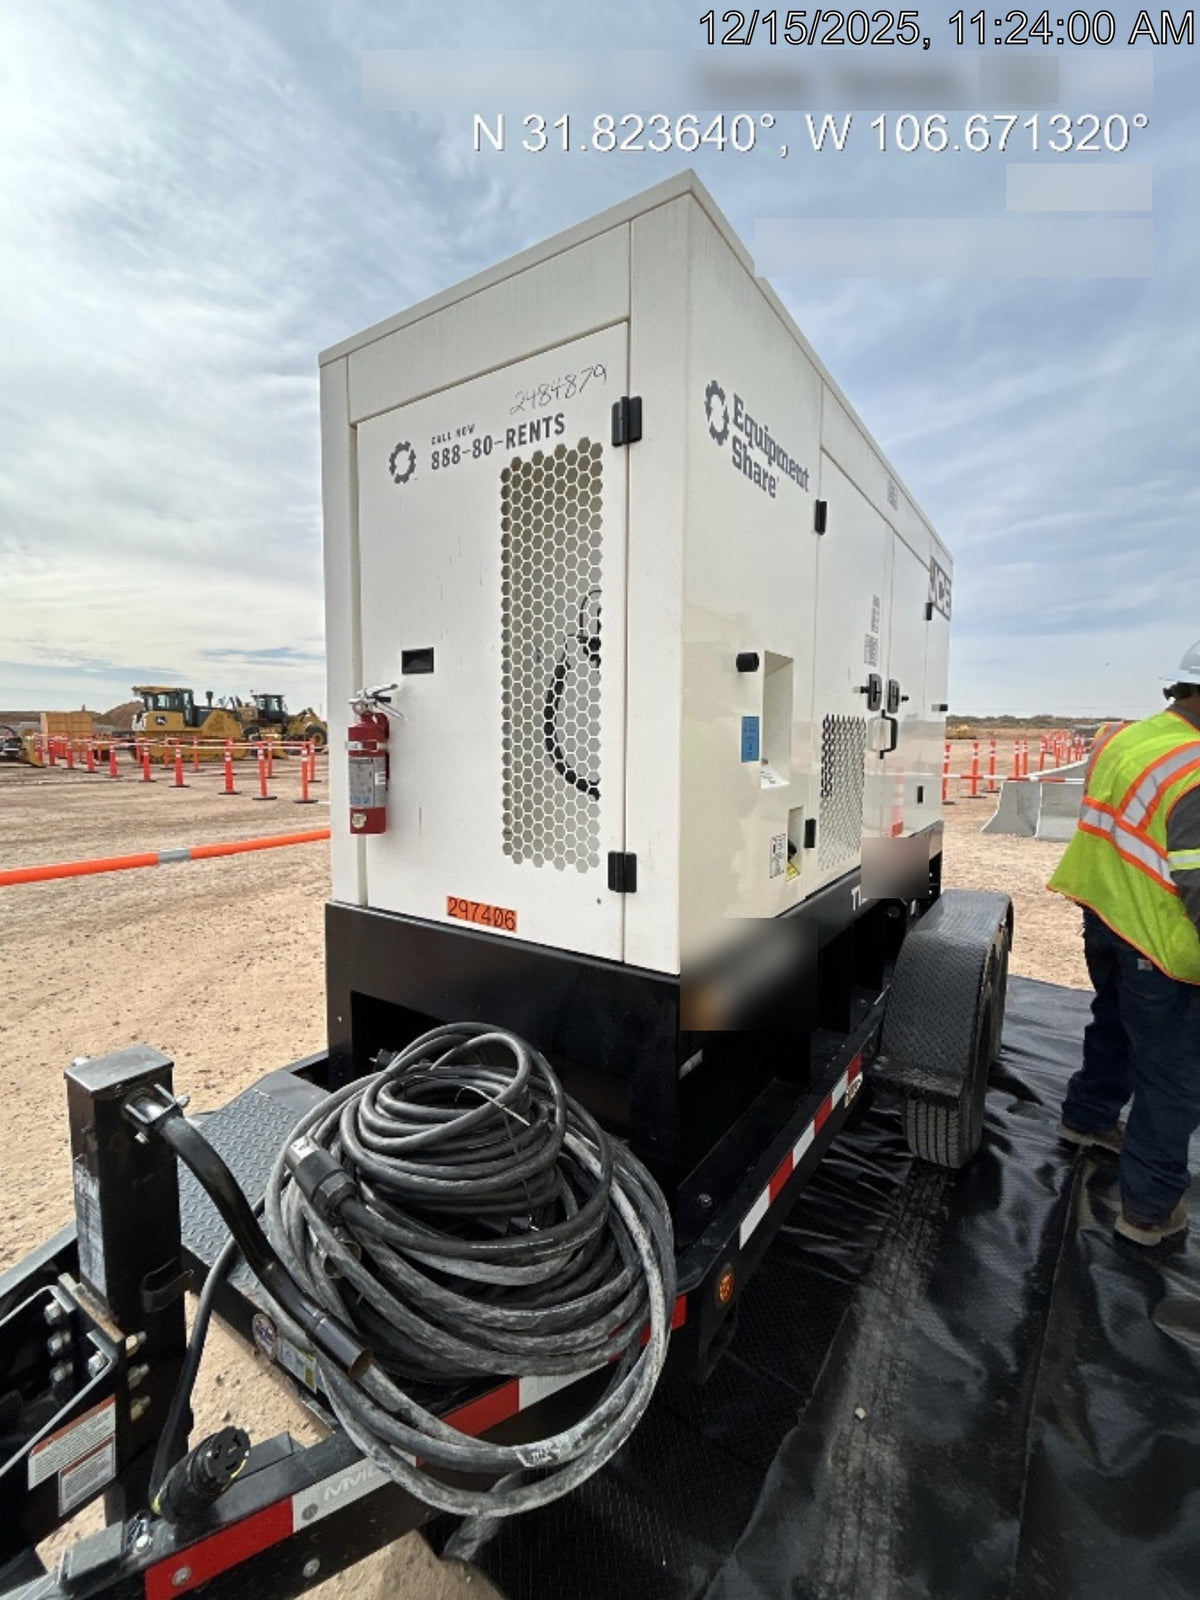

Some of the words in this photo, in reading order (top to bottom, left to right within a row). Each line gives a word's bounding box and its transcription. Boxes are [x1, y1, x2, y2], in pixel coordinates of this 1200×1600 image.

[431, 412, 566, 470] 888-80-RENTS
[731, 434, 776, 499] Share
[733, 392, 810, 493] Equipment
[447, 897, 516, 931] 297406
